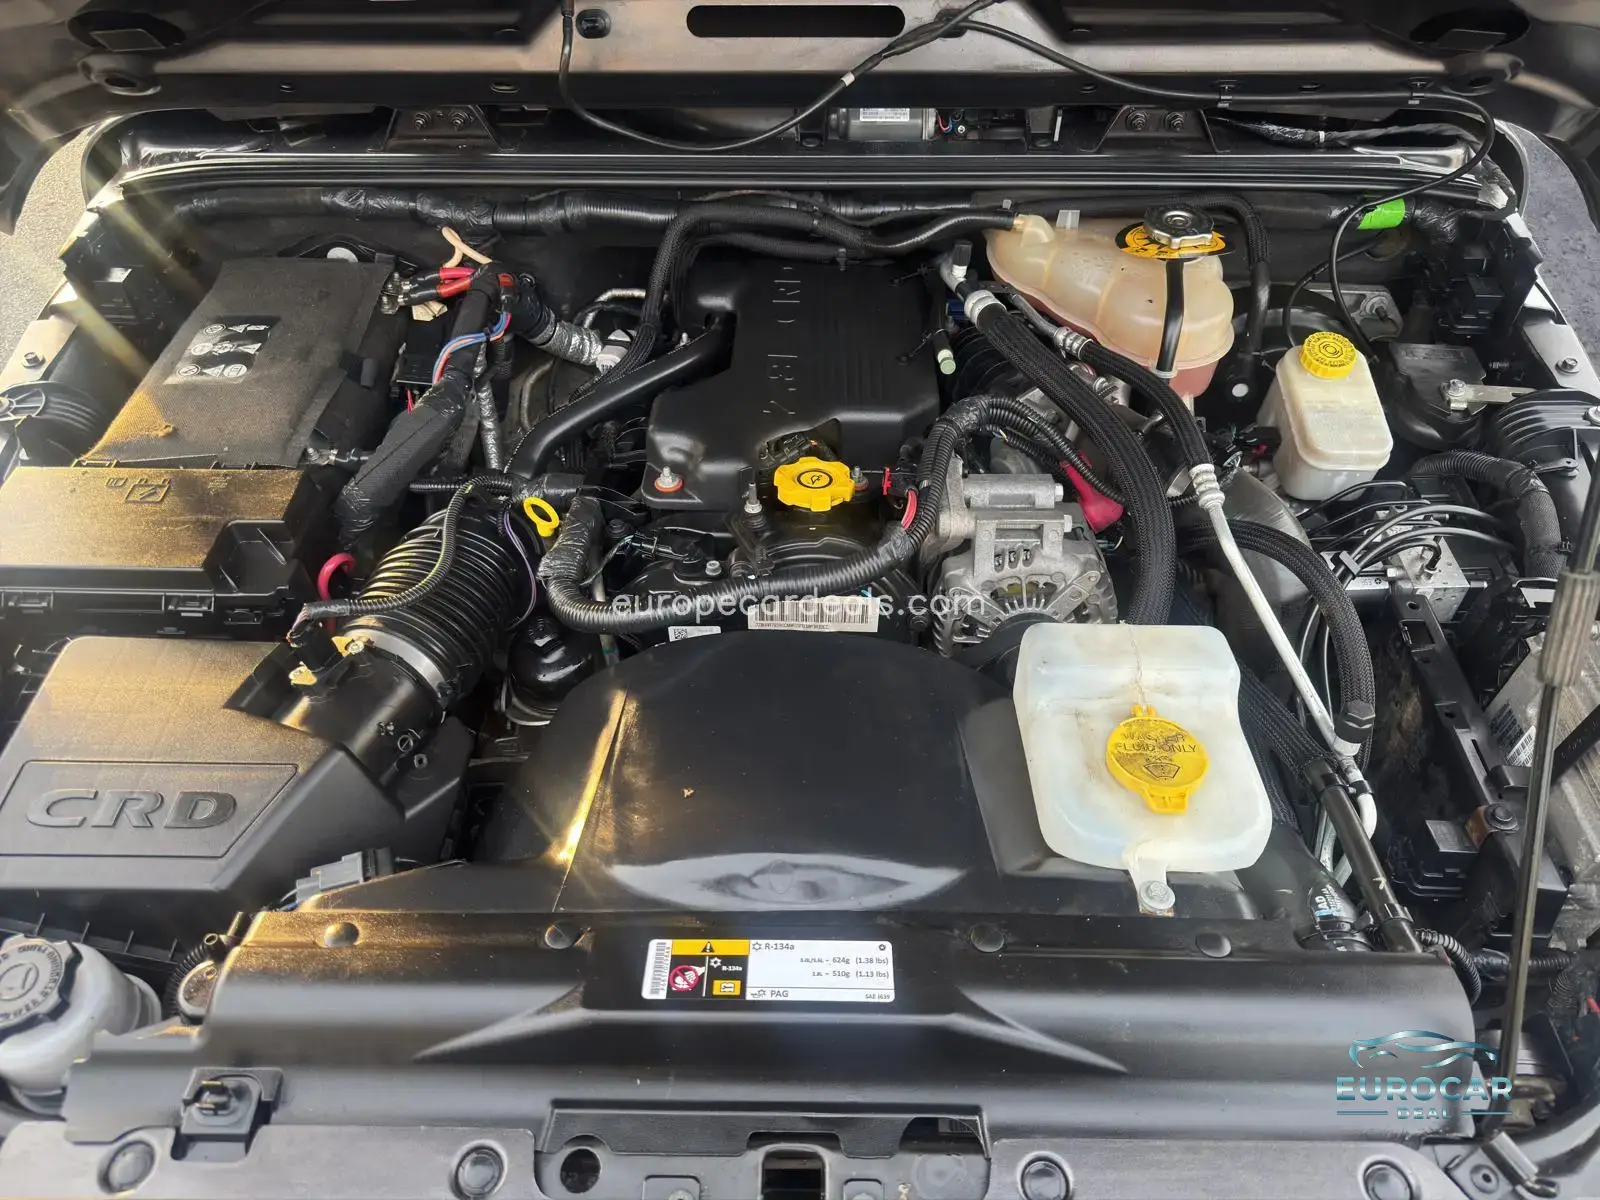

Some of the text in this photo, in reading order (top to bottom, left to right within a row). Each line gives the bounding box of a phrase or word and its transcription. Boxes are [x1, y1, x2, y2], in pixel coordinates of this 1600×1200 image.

[1116, 743, 1197, 753] FLUID ONLY
[25, 788, 238, 829] CRD
[764, 942, 795, 951] R-134a
[832, 956, 851, 965] 624g
[855, 956, 874, 965] (1.38
[875, 956, 889, 966] lbs)
[832, 970, 851, 979] 510g
[855, 970, 874, 979] (1.13
[875, 970, 890, 980] lbs)
[770, 989, 790, 998] PAG
